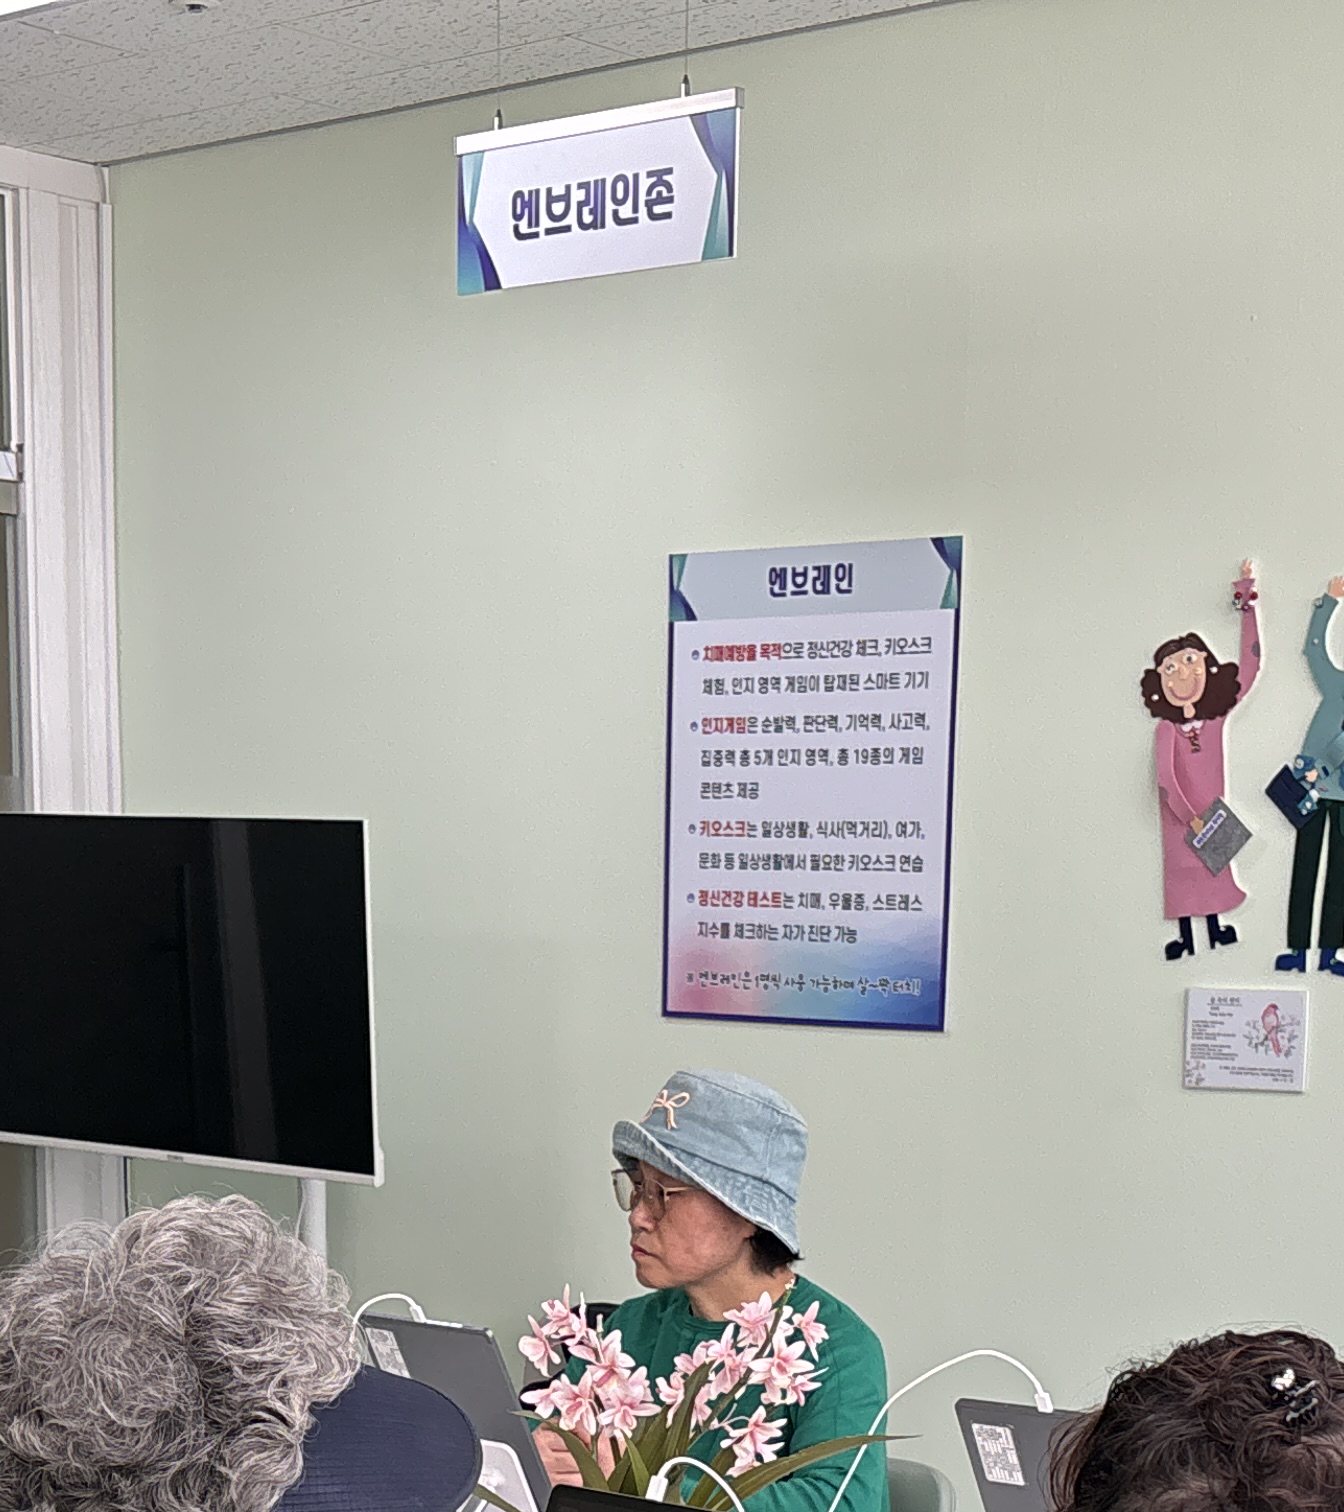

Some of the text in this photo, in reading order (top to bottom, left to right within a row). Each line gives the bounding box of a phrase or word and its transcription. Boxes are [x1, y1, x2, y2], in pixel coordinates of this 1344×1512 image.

[511, 167, 674, 241] 엔브레인존
[768, 562, 854, 598] 엔브레인
[759, 642, 805, 661] 목적으로
[807, 640, 852, 659] 정신건강
[884, 636, 932, 656] 키오스크
[732, 678, 754, 694] 인지
[758, 676, 781, 694] 영역
[784, 675, 820, 694] 게임이
[824, 674, 859, 692] 탑재된
[864, 672, 900, 691] 스마트
[904, 672, 929, 690] 기기
[701, 716, 758, 735] 인지게임은
[701, 750, 736, 767] 집중력
[754, 748, 773, 766] 5개
[777, 748, 800, 766] 인지
[853, 747, 894, 765] 19종의
[898, 746, 924, 765] 게임
[736, 782, 759, 799] 제공
[699, 821, 757, 838] 키오스크는
[698, 852, 924, 873] 문화 등 일상생활에서 필요한 키오스크 연습
[698, 890, 744, 908] 정신건강
[747, 891, 795, 910] 테스트는
[872, 893, 923, 912] 스트레스
[697, 922, 857, 944] 지수를 체크하는 자가 진단 가능
